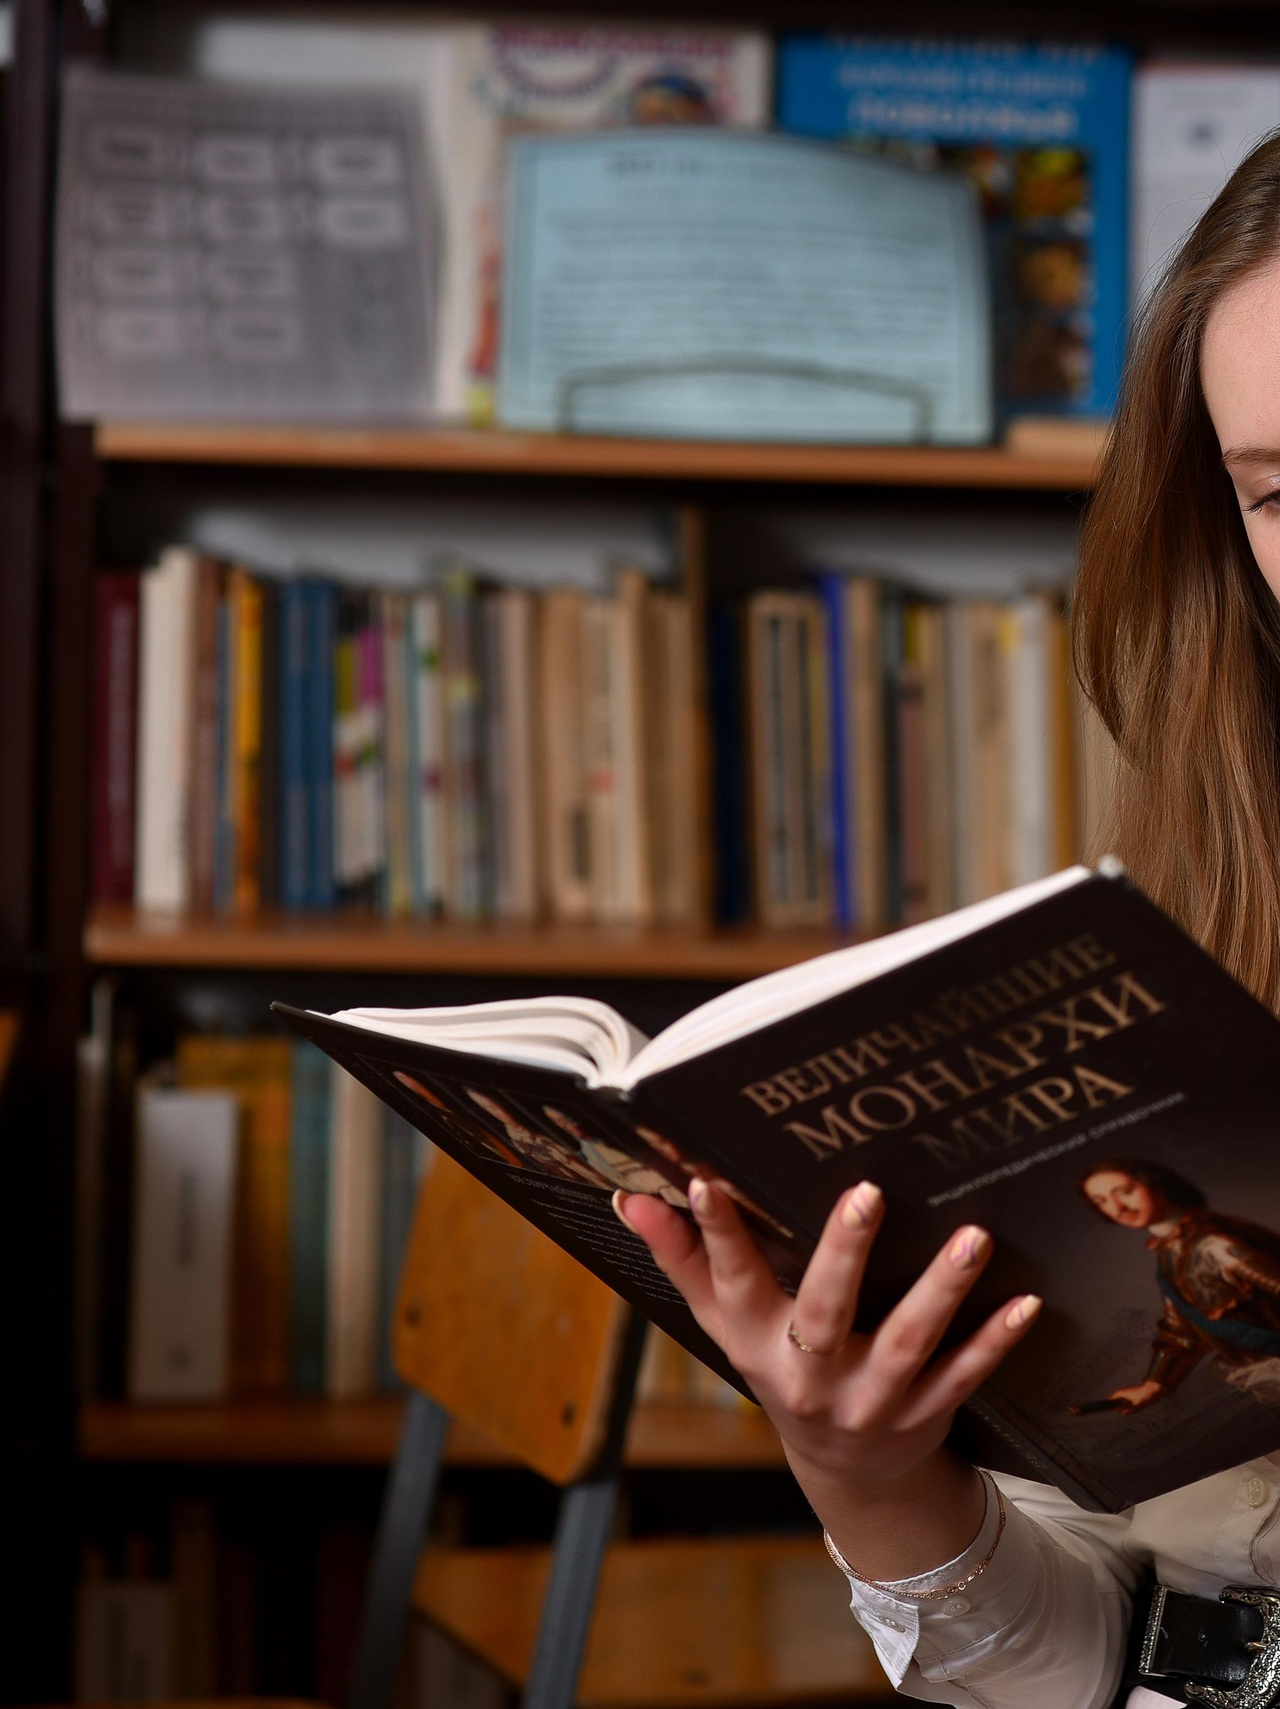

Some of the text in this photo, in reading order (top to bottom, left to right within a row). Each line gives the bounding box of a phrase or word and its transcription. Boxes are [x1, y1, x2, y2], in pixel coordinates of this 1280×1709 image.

[739, 932, 1118, 1116] ВЕЛИЧАЙШИЕ
[781, 971, 1168, 1161] МОНАРХИ
[910, 1064, 1137, 1172] МИРА
